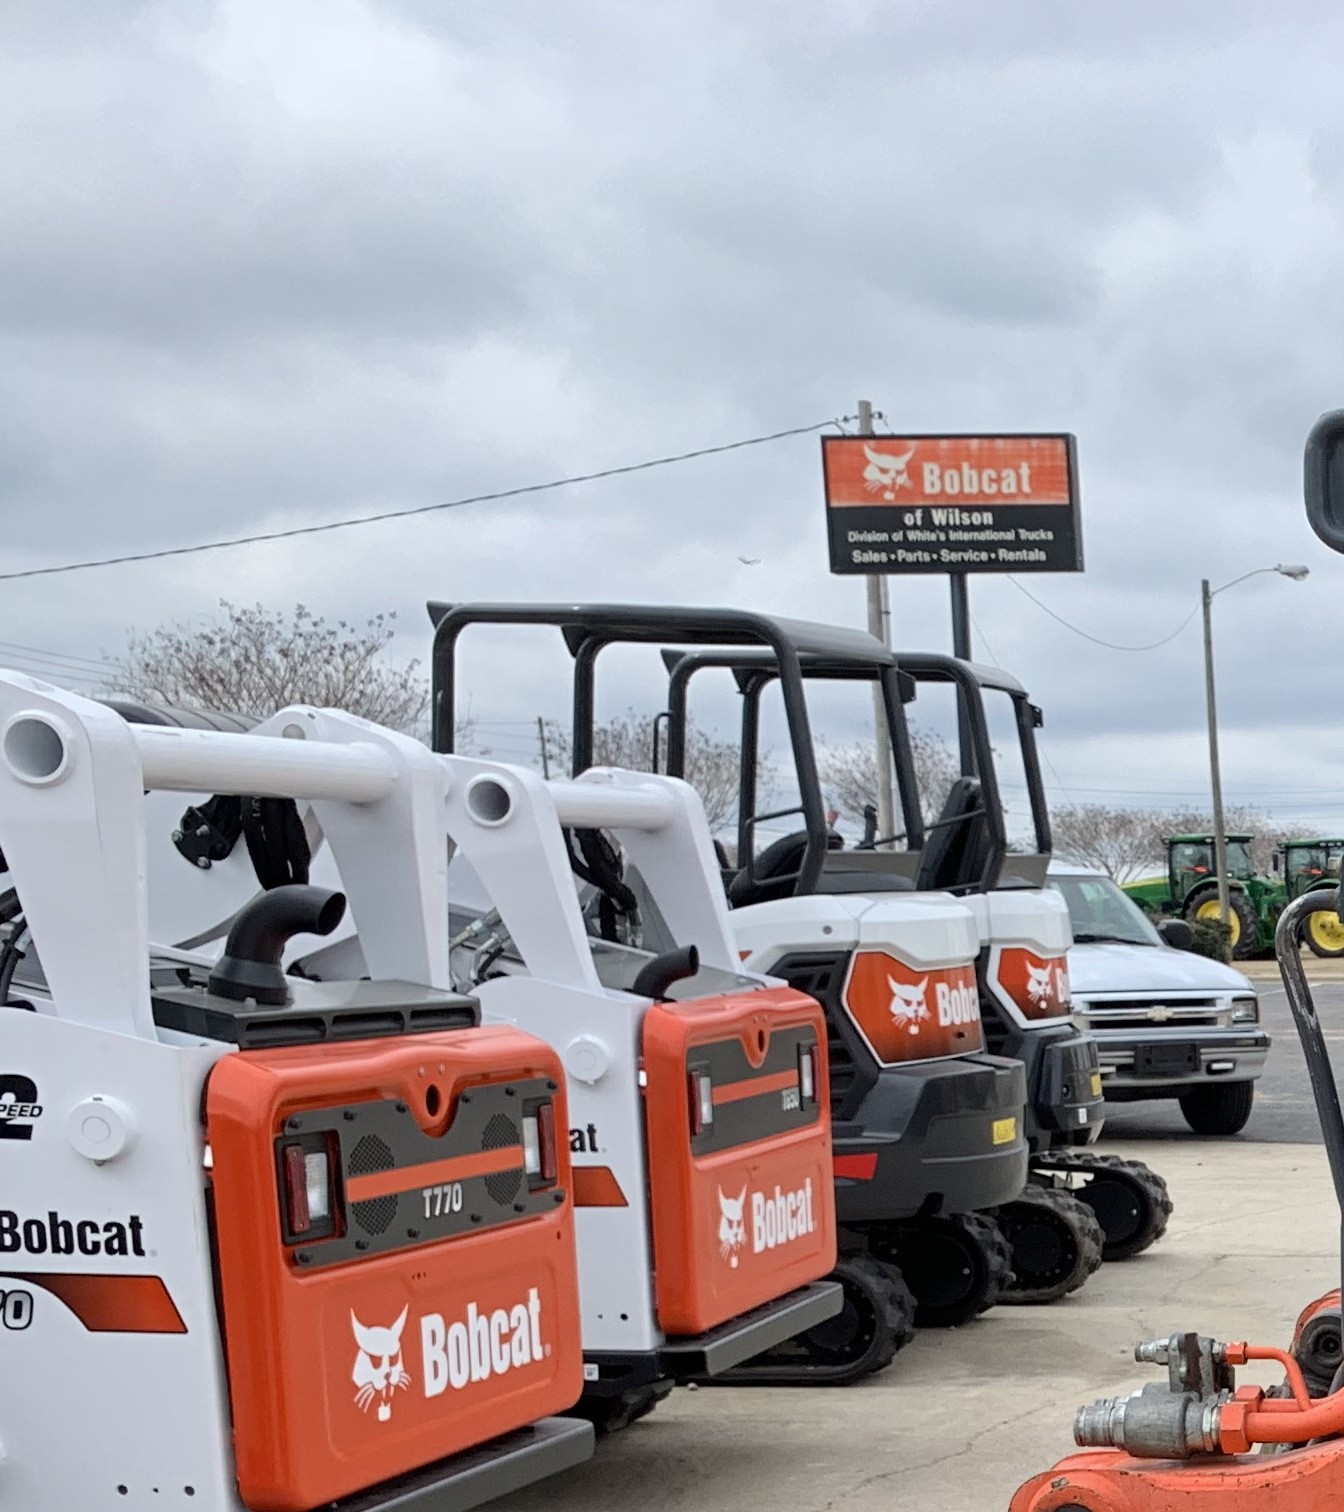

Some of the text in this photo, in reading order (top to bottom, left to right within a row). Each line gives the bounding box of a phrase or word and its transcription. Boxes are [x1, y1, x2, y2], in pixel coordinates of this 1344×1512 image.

[922, 461, 1032, 495] Bobcat
[904, 508, 994, 526] of Wilson
[848, 528, 1054, 542] Division of White's International Trucks
[852, 548, 1046, 563] Sales Parts Service Rentals
[0, 1104, 43, 1117] PEED
[422, 1182, 463, 1219] T770
[752, 1177, 814, 1254] Bobcat
[0, 1210, 146, 1256] Bobcat
[420, 1287, 543, 1398] Bobcat
